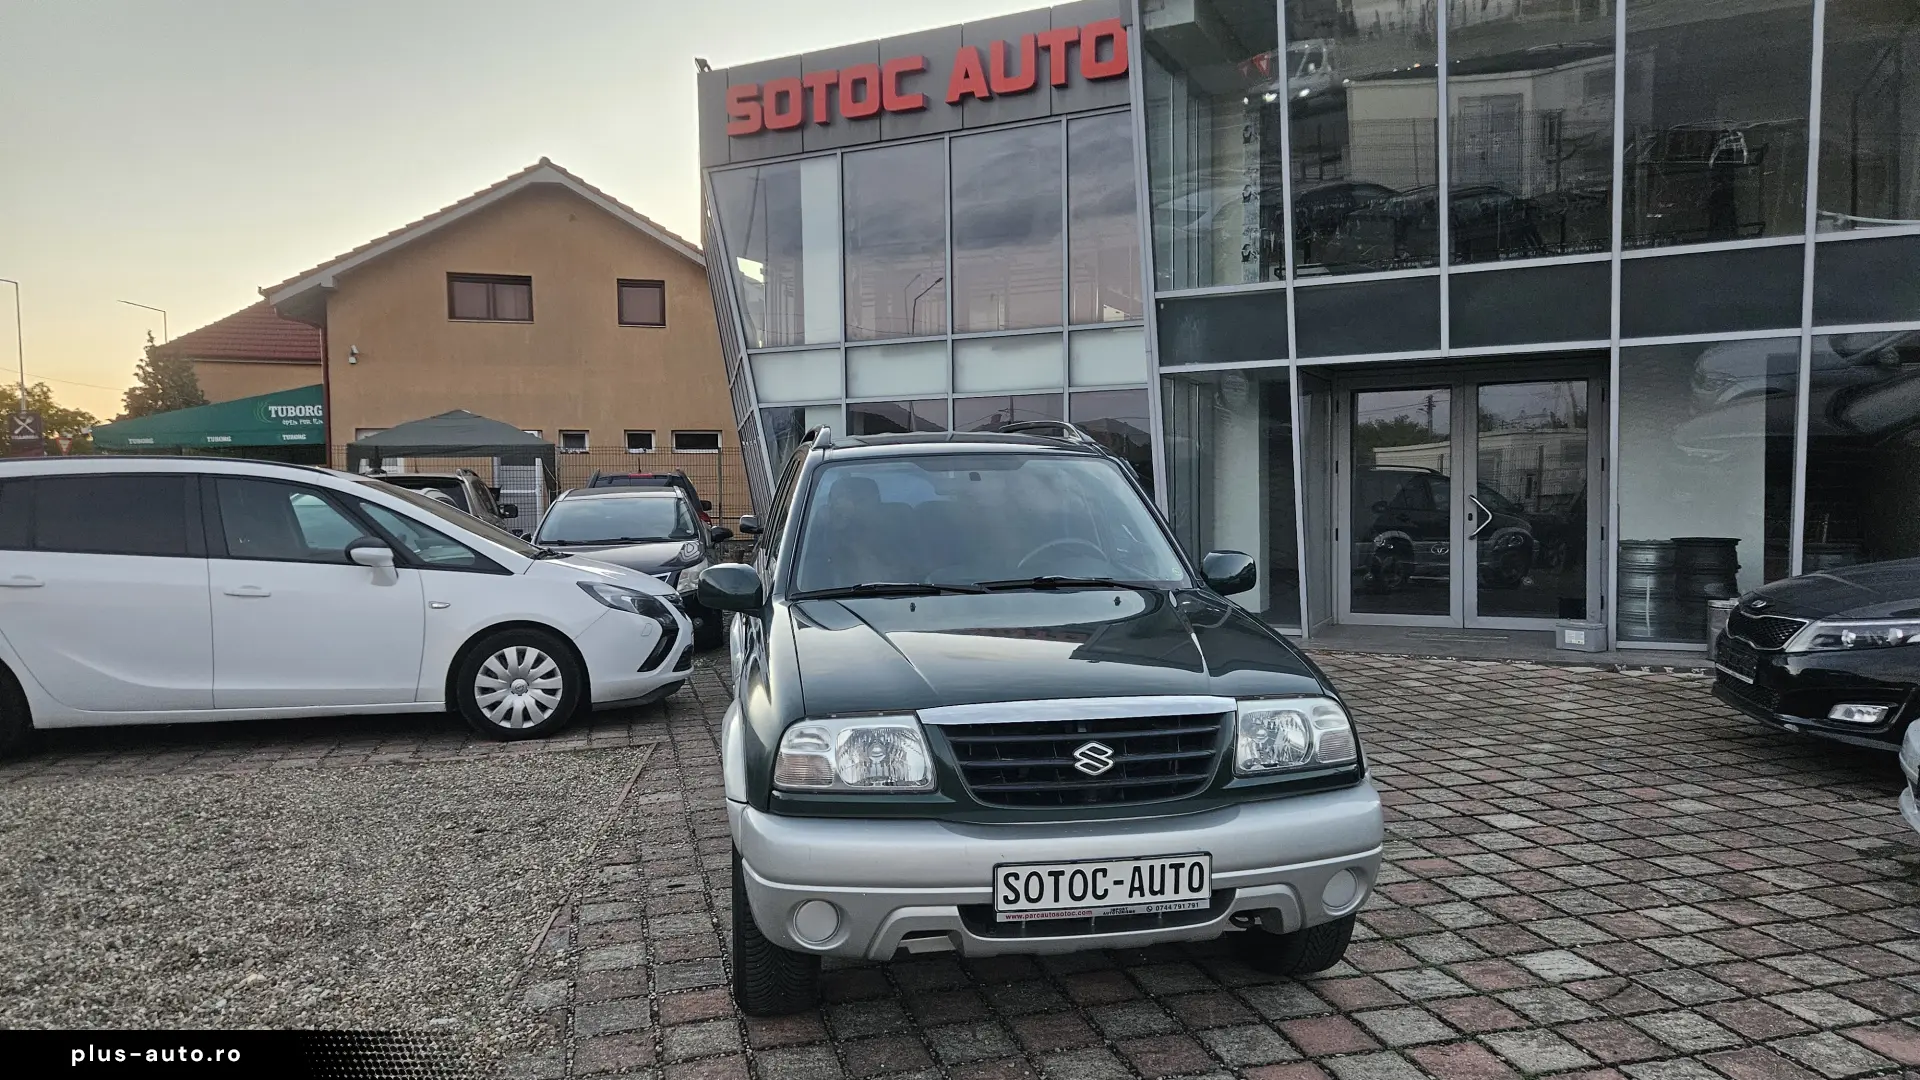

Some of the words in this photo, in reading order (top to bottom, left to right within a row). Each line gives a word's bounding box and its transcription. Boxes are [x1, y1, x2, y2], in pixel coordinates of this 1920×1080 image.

[727, 55, 928, 137] SOTOC
[945, 18, 1129, 105] AUTO
[268, 404, 323, 418] TUBORG
[1002, 861, 1205, 905] SOTOC-AUTO
[1005, 909, 1093, 920] www.parcautosotoc.com
